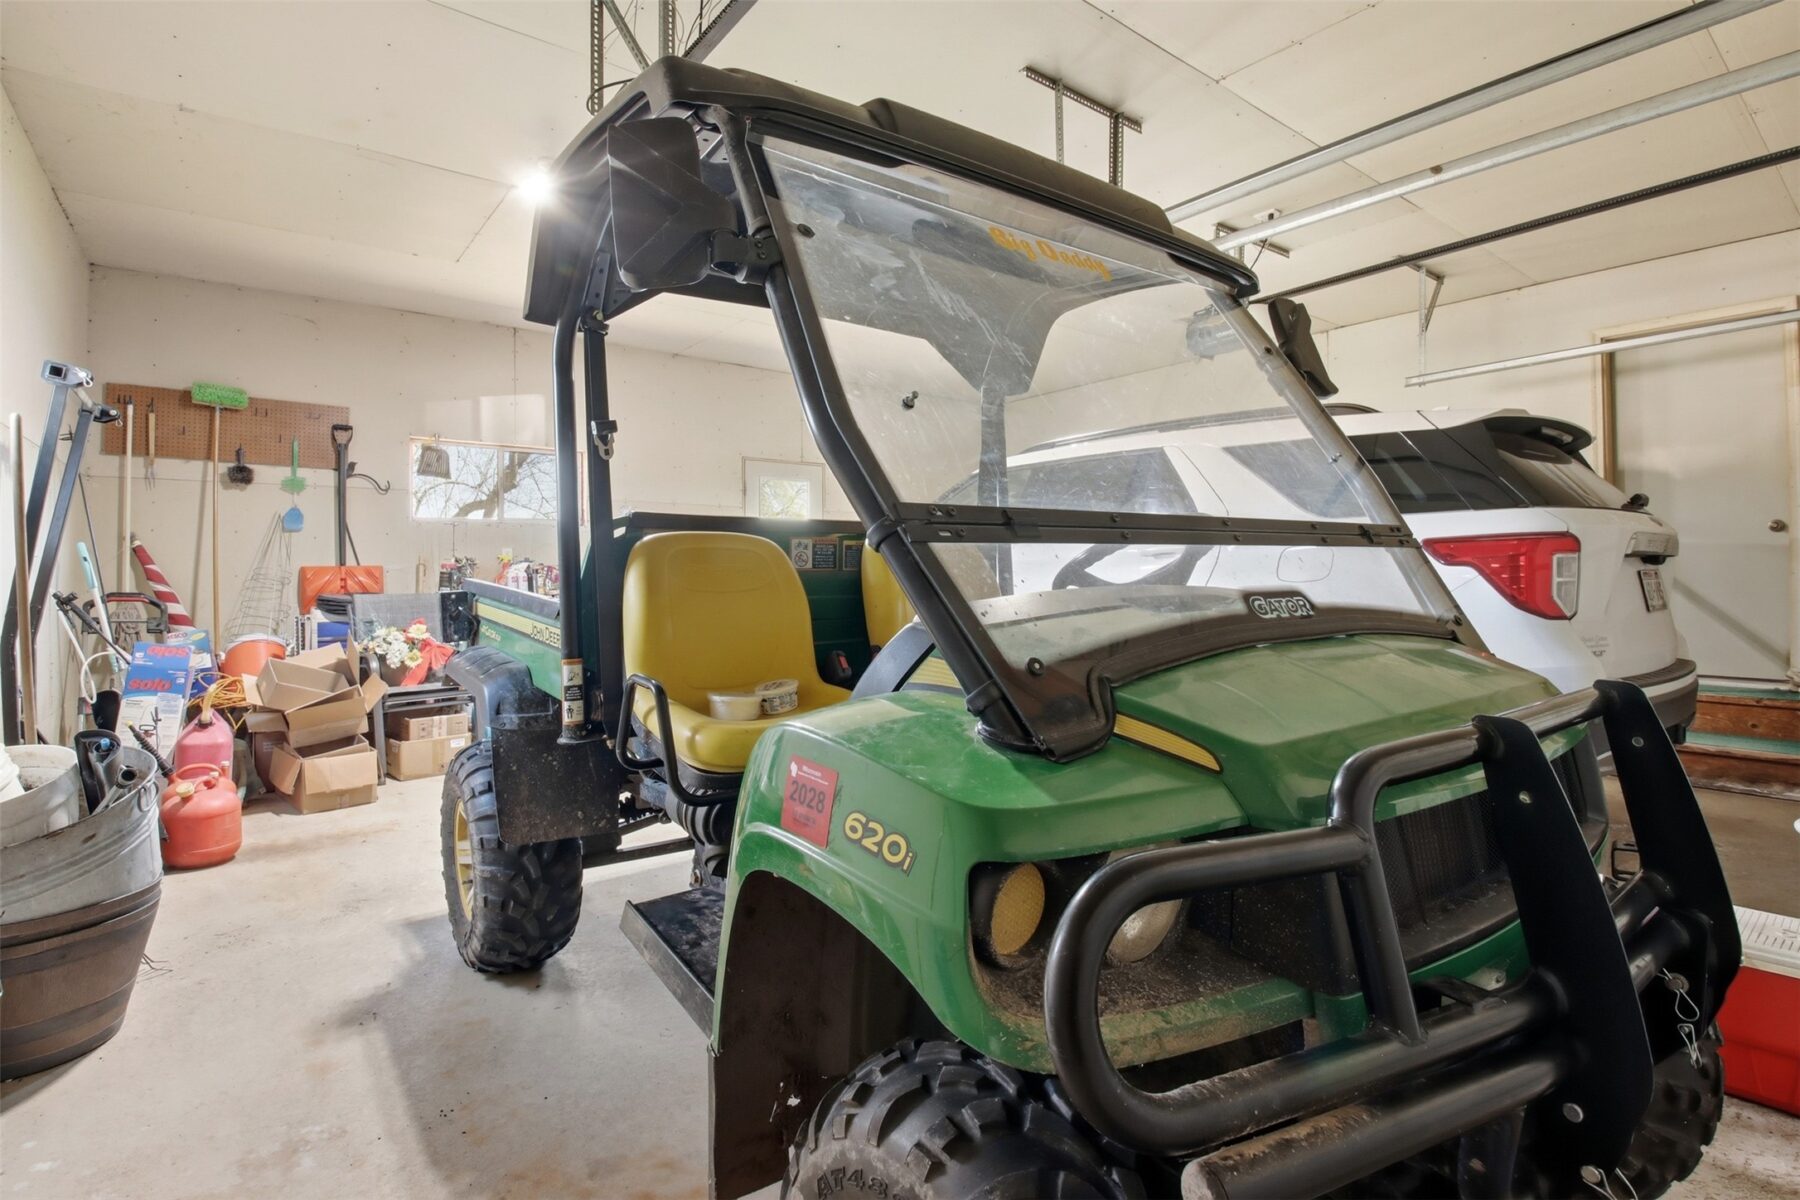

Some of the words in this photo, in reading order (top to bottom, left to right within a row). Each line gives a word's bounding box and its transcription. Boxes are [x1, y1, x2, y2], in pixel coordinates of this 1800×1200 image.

[1249, 596, 1315, 618] GATOR
[530, 625, 546, 642] JOHN
[544, 627, 561, 648] DEER
[128, 678, 172, 691] solo
[789, 780, 827, 814] 2028
[844, 811, 916, 874] 620i
